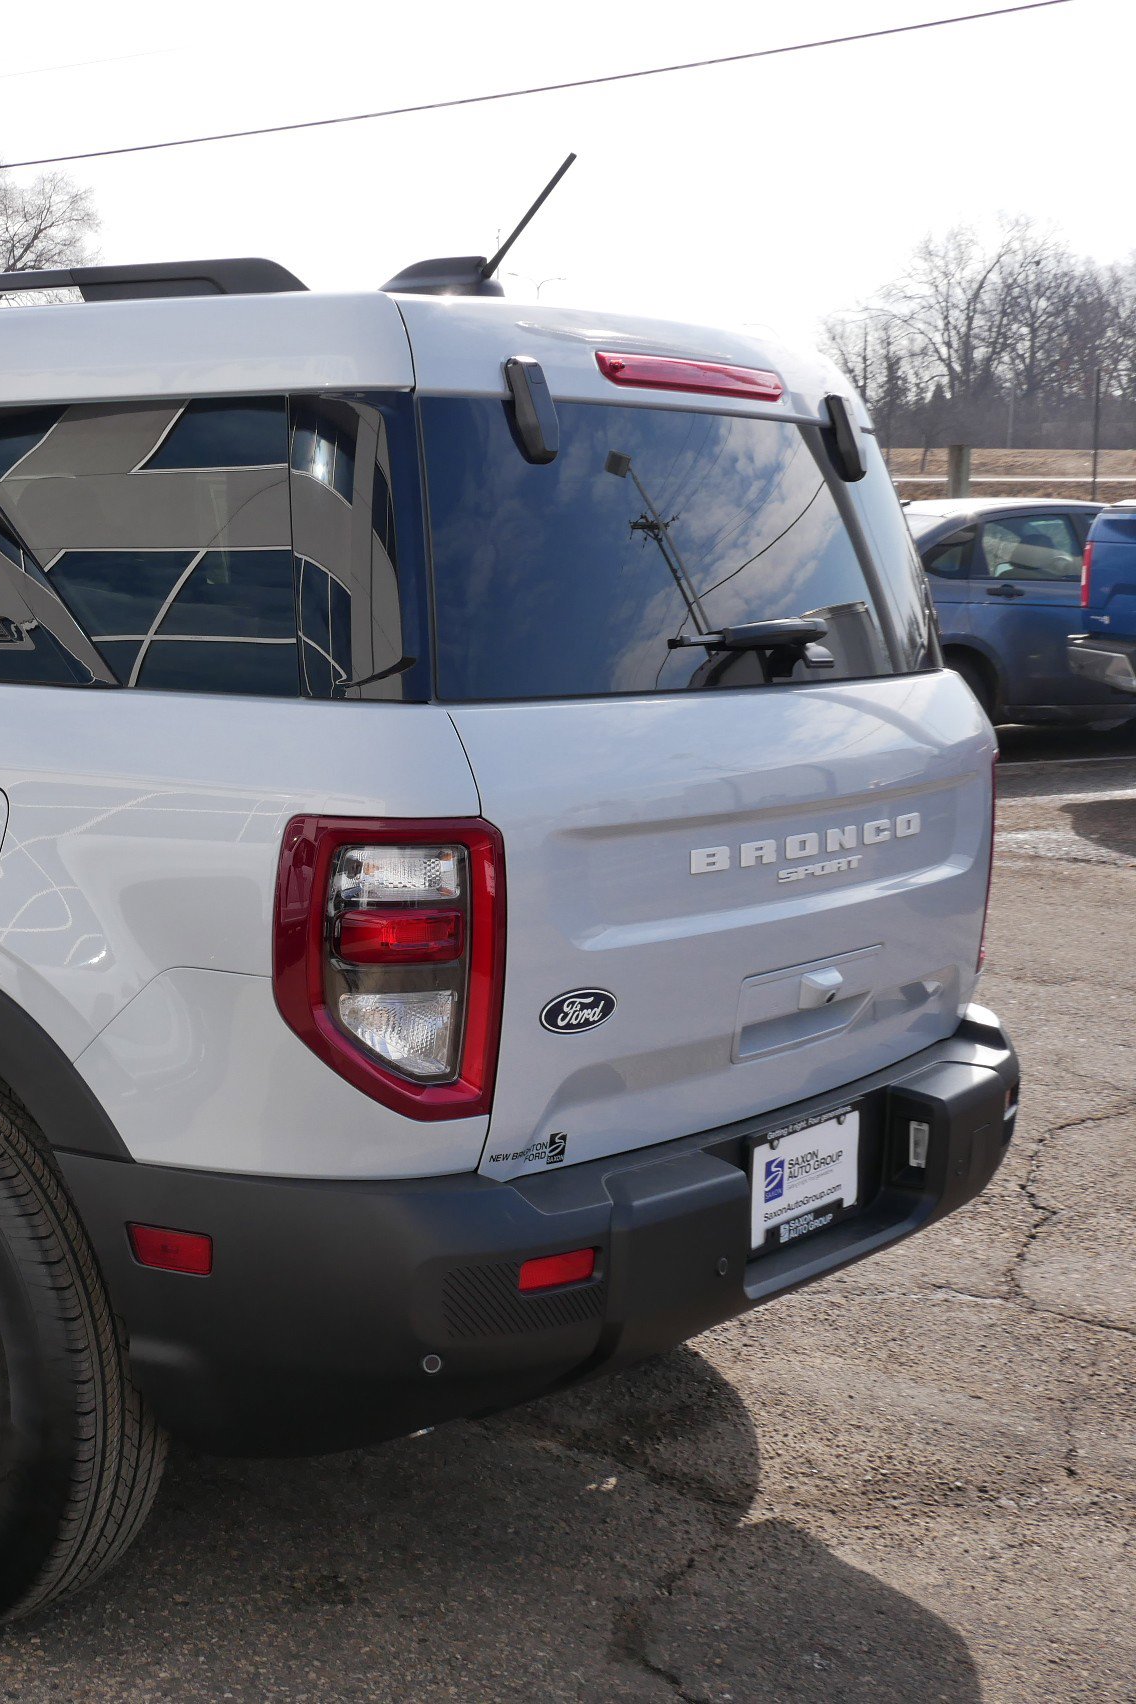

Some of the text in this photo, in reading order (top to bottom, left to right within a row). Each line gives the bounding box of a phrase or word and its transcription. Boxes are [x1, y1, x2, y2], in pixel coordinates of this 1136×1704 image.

[690, 812, 921, 875] BRONCO
[777, 854, 863, 883] SPORT
[557, 996, 605, 1027] Ford
[767, 1127, 788, 1140] Getting
[808, 1116, 821, 1126] Four
[488, 1152, 512, 1163] NEW
[523, 1151, 547, 1164] FORD
[546, 1154, 565, 1163] SAXON
[787, 1163, 812, 1181] AUTO
[813, 1150, 843, 1171] GROUP
[788, 1149, 819, 1169] SAXON
[764, 1184, 842, 1222] SaxonAutoGroup.com
[765, 1187, 783, 1200] SAXON
[789, 1212, 814, 1230] SAXON
[789, 1223, 808, 1240] AUTO
[808, 1213, 833, 1231] GROUP
